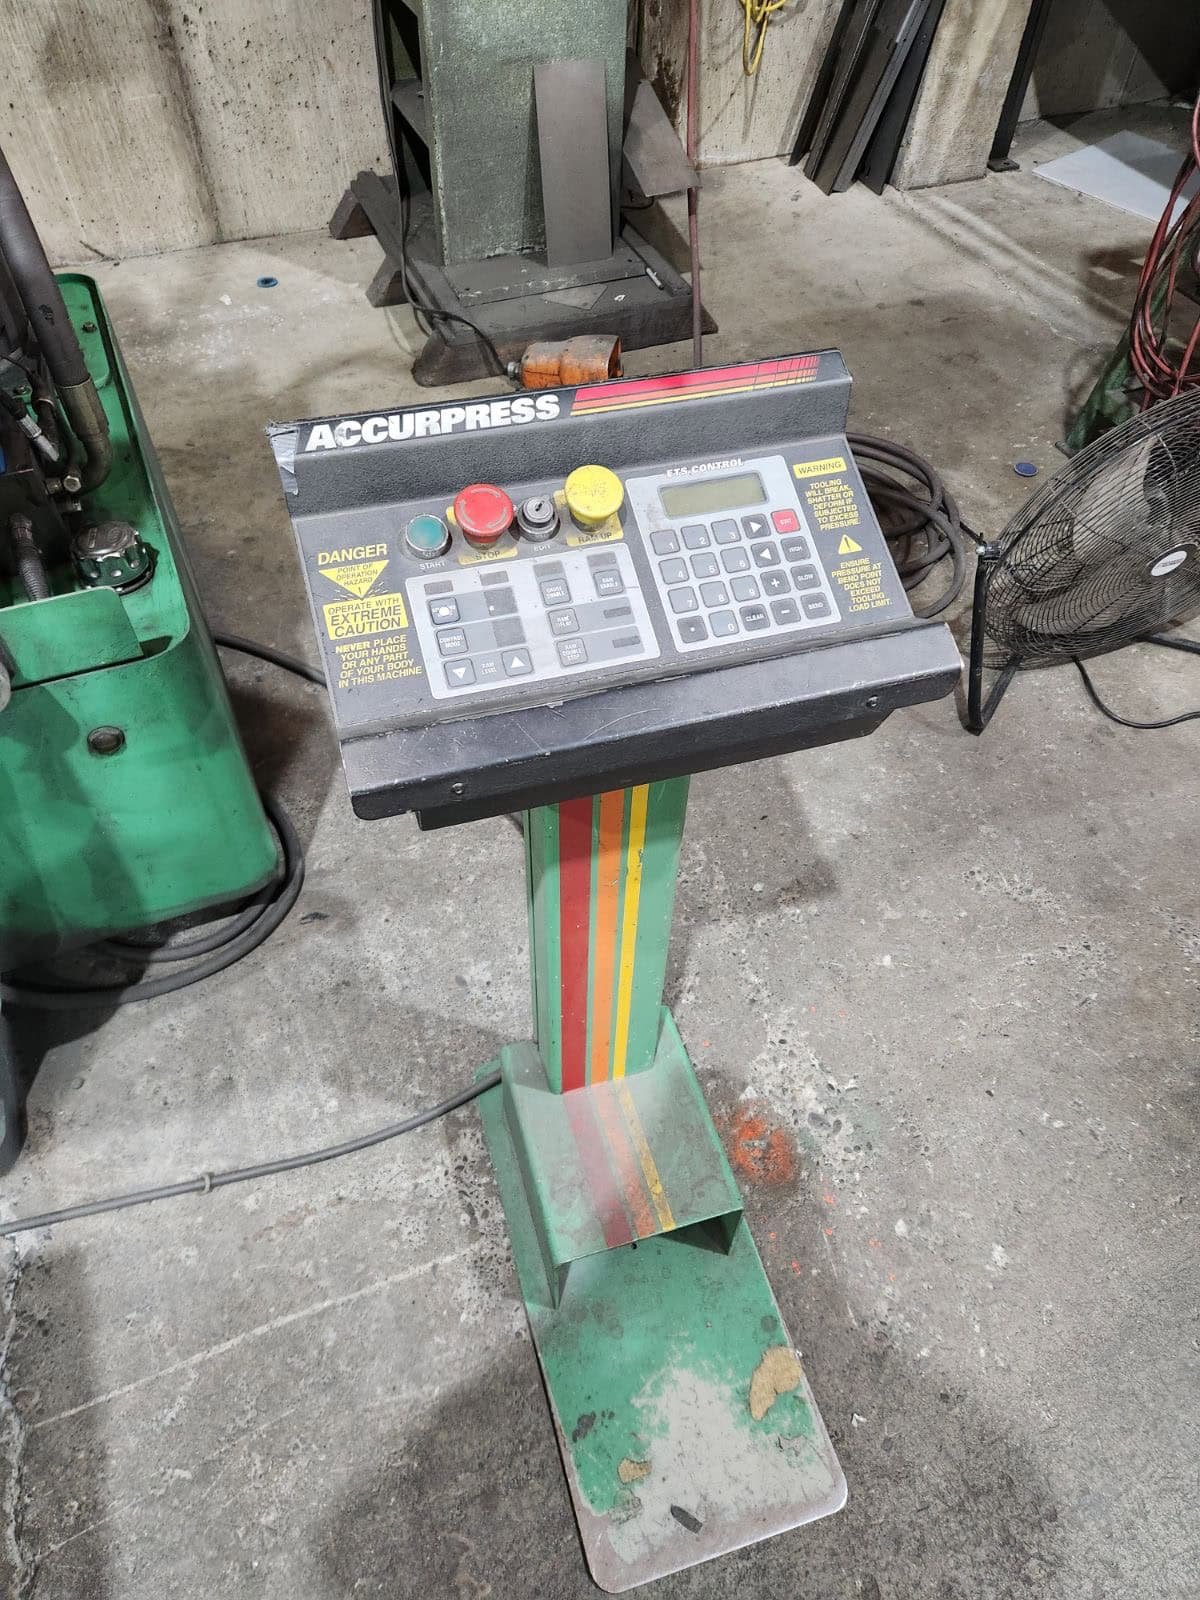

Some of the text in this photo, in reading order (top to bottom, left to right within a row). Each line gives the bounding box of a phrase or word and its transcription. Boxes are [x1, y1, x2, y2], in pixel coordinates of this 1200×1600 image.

[304, 394, 560, 451] ACCURPRESS
[692, 459, 743, 472] CONTROL
[798, 461, 841, 474] WARNING
[810, 478, 842, 489] TOOLING
[805, 489, 823, 498] WILL
[807, 490, 854, 504] SHATTER OR
[813, 497, 853, 510] DEFORM IF
[814, 504, 857, 517] SUBJECTED
[817, 510, 859, 524] TO EXCESS
[577, 531, 612, 544] RAM UP
[317, 543, 387, 566] DANGER
[475, 550, 500, 560] STOP
[338, 565, 360, 574] POINT
[419, 559, 445, 570] START
[708, 565, 715, 573] 5
[739, 560, 746, 568] 6
[840, 557, 870, 569] ENSURE
[336, 569, 378, 580] OPERATION
[831, 562, 881, 578] PRESSURE AT
[838, 569, 882, 584] BEND POINT
[344, 577, 373, 586] HAZARD
[843, 577, 881, 590] DOES NOT
[850, 585, 880, 597] EXCEED
[687, 599, 693, 607] 7
[718, 594, 725, 602] 8
[851, 592, 884, 604] TOOLING
[328, 597, 400, 616] OPERATE WITH
[849, 602, 870, 612] LOAD
[330, 605, 402, 626] EXTREME
[746, 613, 764, 622] CLEAR
[334, 617, 401, 638] CAUTION
[728, 623, 734, 631] 0
[335, 634, 407, 654] NEVER PLACE
[341, 643, 406, 661] YOUR HANDS
[342, 651, 408, 670] OR ANY PART
[340, 658, 414, 679] OF YOUR BODY
[338, 666, 422, 688] IN THIS MACHINE
